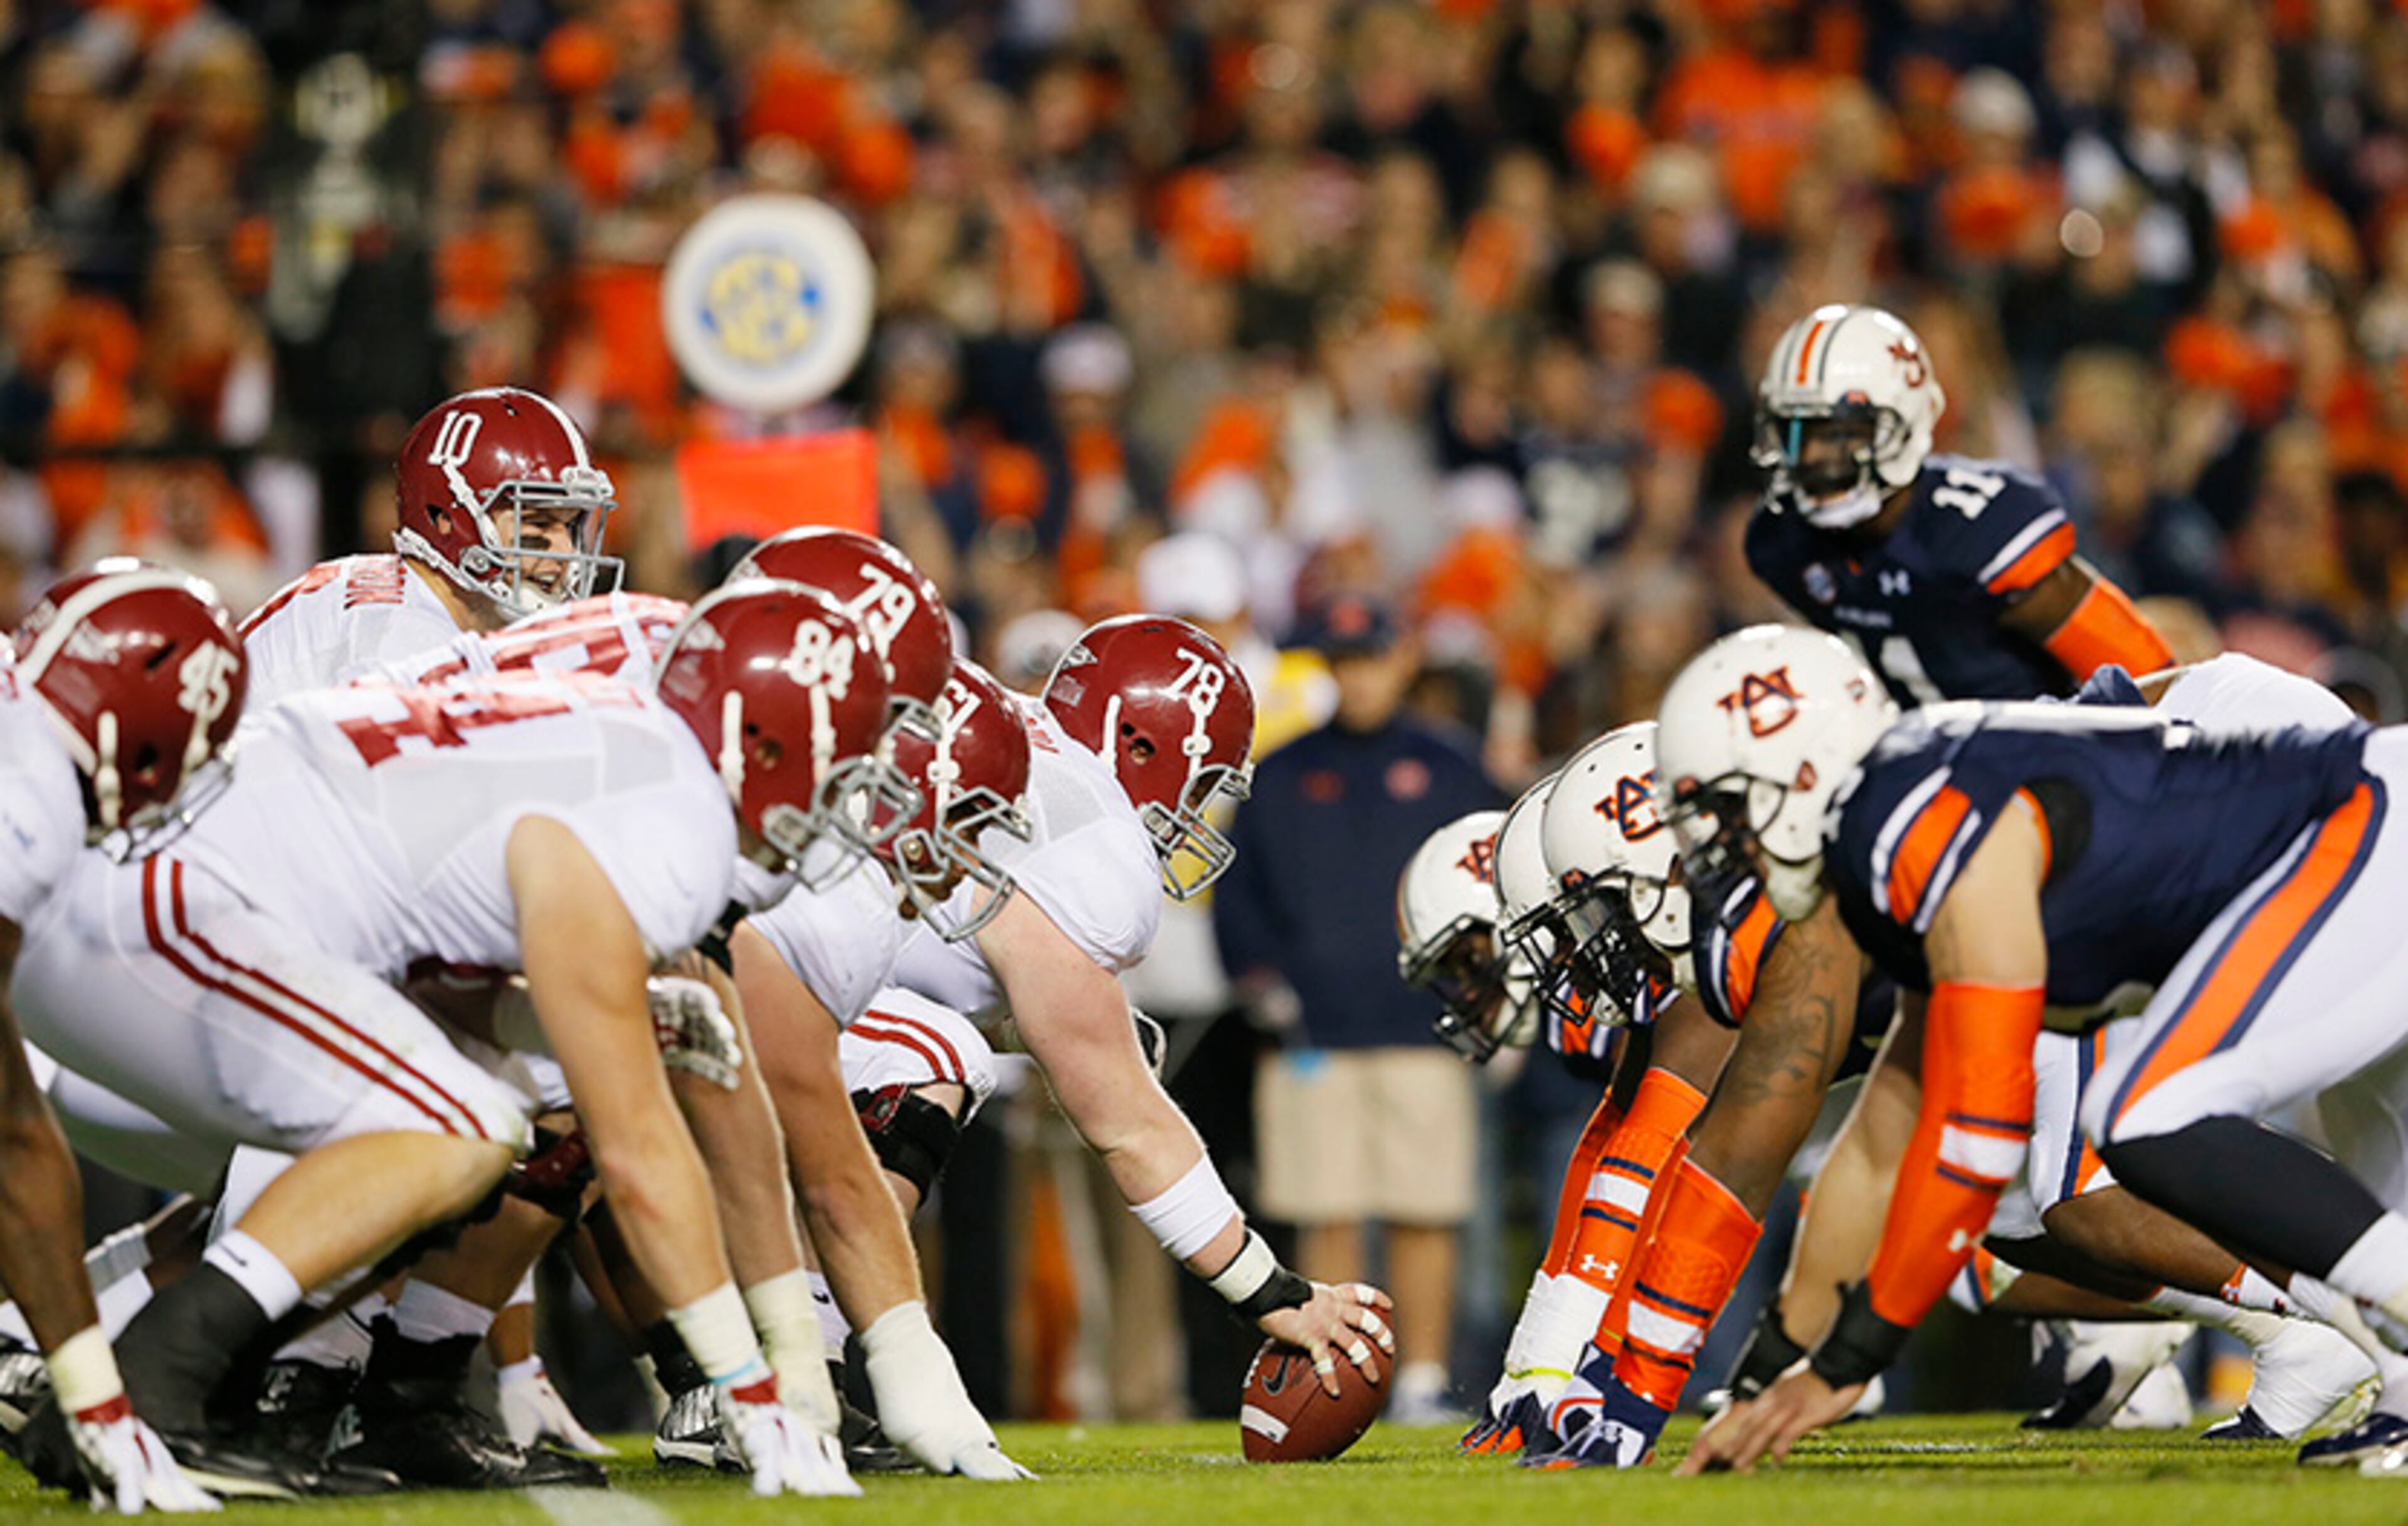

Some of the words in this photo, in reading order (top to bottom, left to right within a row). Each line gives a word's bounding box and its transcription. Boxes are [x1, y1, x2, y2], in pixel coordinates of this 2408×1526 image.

[427, 410, 483, 465] 10
[1933, 469, 2006, 519] 11
[843, 562, 916, 645] 79
[177, 638, 240, 721] 45
[788, 618, 854, 701] 84
[1168, 647, 1225, 717] 78
